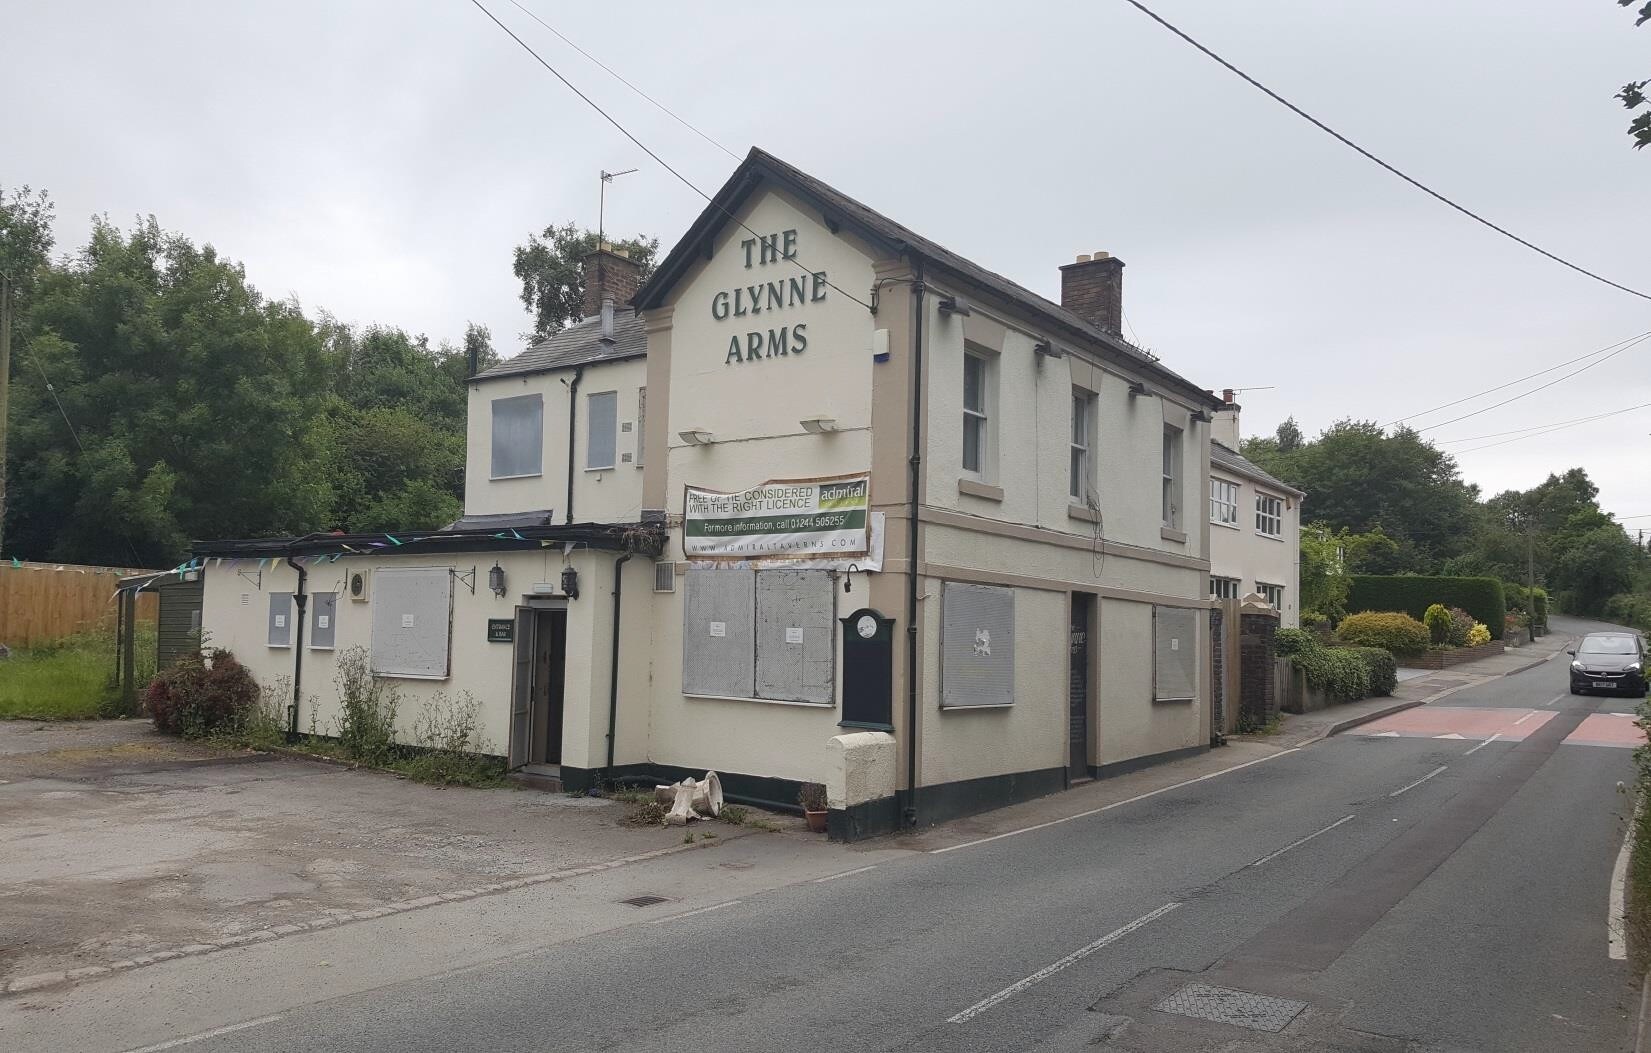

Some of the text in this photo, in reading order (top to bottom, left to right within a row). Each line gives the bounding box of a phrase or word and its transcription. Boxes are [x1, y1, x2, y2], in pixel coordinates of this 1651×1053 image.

[741, 229, 797, 268] THE
[712, 271, 827, 320] GLYNNE
[725, 323, 807, 364] ARMS
[689, 493, 708, 503] FREE
[744, 487, 812, 501] CONSIDERED
[821, 483, 864, 500] admiral
[689, 503, 709, 513] WITH
[711, 503, 729, 513] THE
[732, 500, 763, 512] RIGHT
[766, 498, 811, 510] LICENCE
[733, 521, 775, 532] information,
[776, 519, 790, 529] call
[791, 517, 814, 529] 01244
[815, 515, 845, 527] 505255
